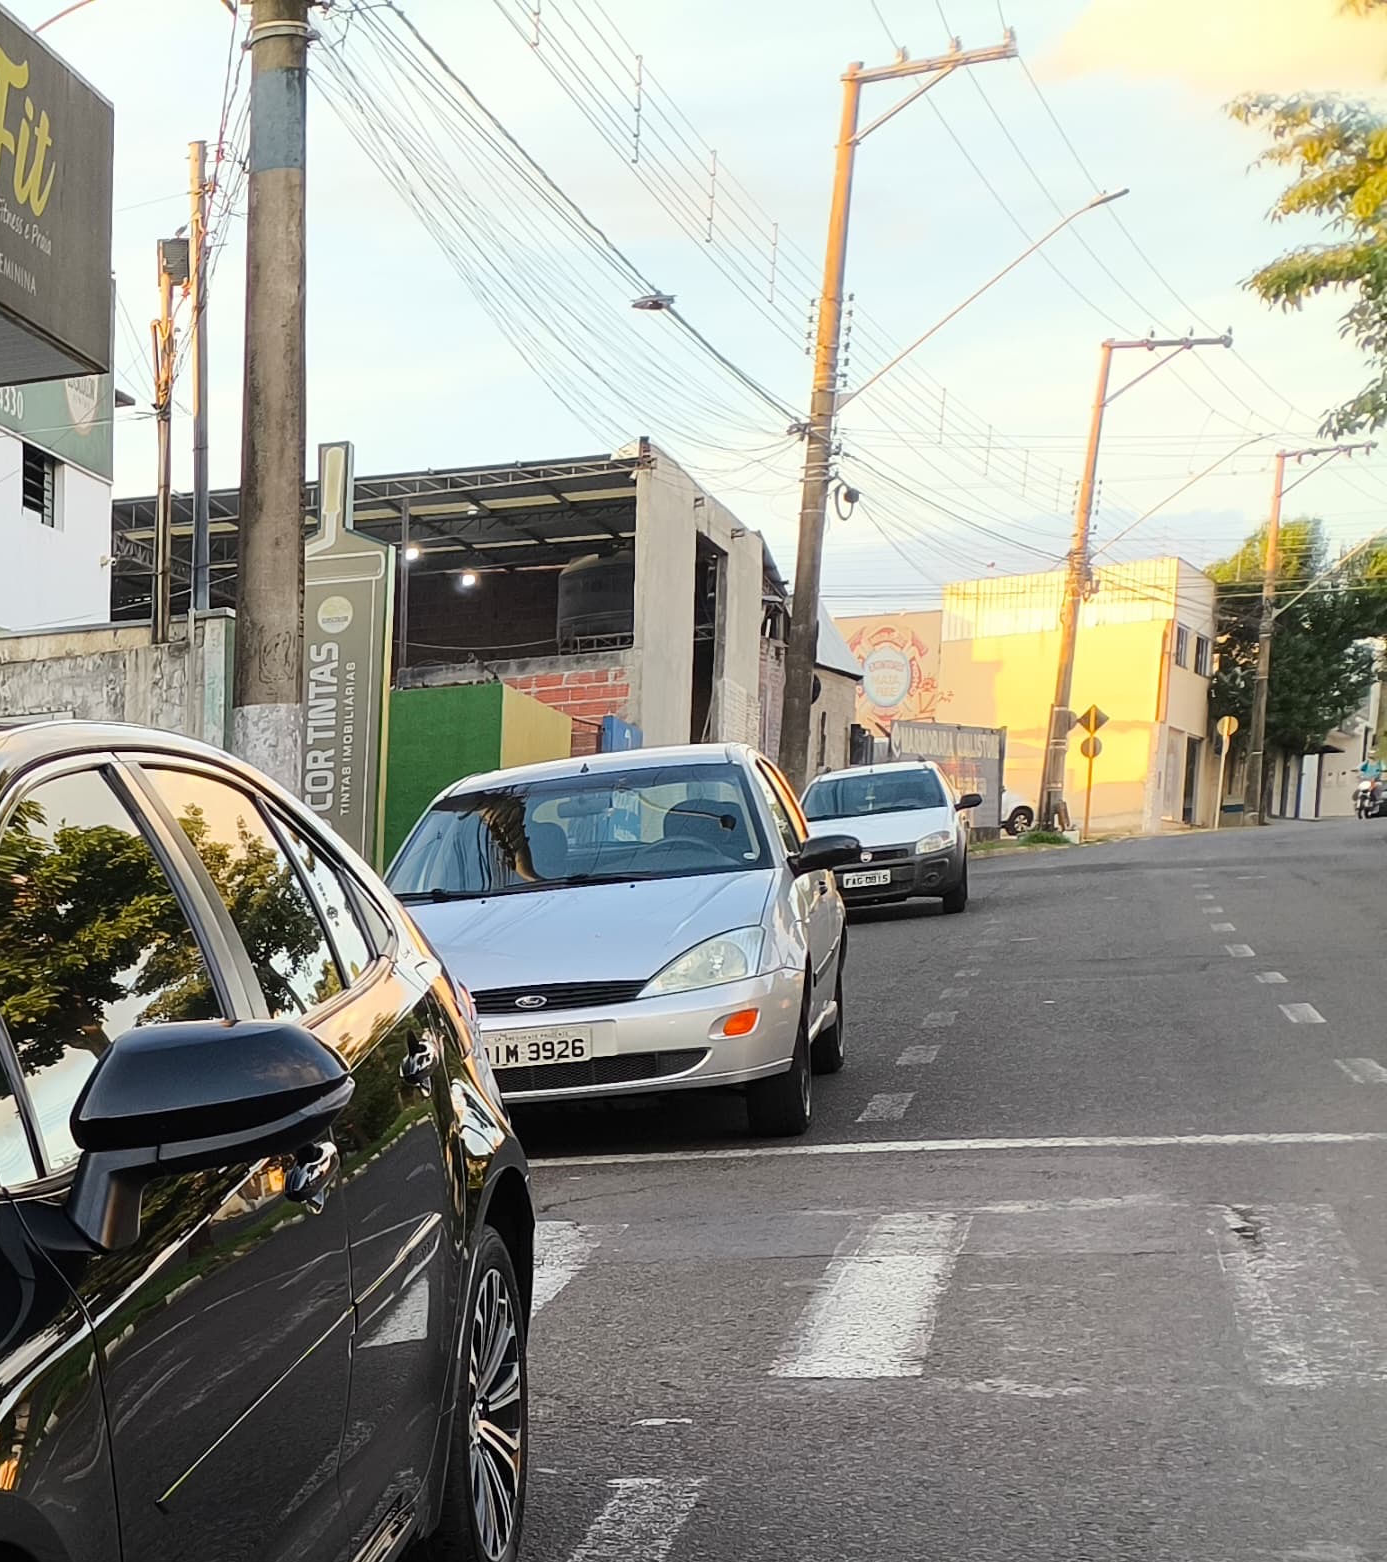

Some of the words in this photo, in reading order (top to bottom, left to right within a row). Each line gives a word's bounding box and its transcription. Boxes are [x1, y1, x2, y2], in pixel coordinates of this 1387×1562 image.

[31, 223, 52, 256] Praia
[307, 640, 340, 745] TINTAS
[304, 748, 335, 812] COR
[339, 767, 353, 817] TINTAS
[527, 1038, 585, 1062] 3926
